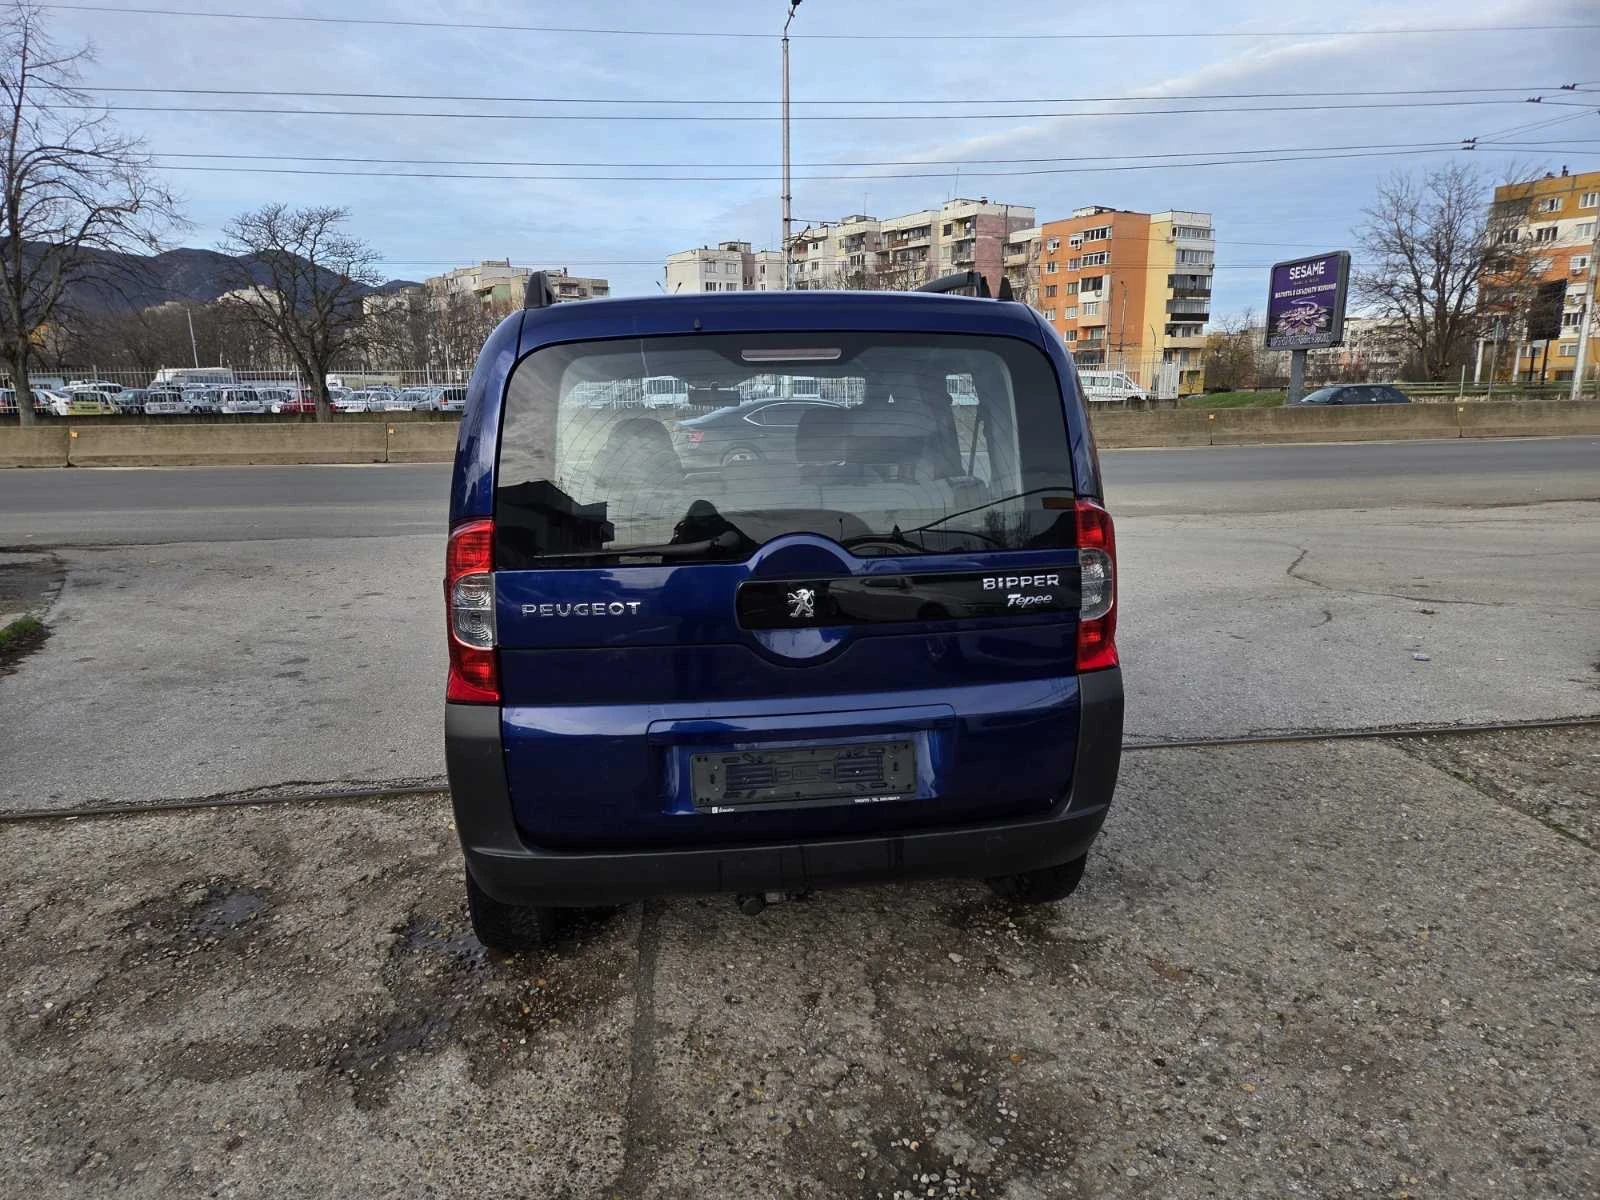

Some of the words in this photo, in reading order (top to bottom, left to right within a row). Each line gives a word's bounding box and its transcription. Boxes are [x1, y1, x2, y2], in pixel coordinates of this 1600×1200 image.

[1289, 261, 1326, 280] SESAME
[982, 574, 1060, 590] BIPPER
[521, 601, 641, 617] PEUGEOT
[1007, 593, 1053, 609] Tepee
